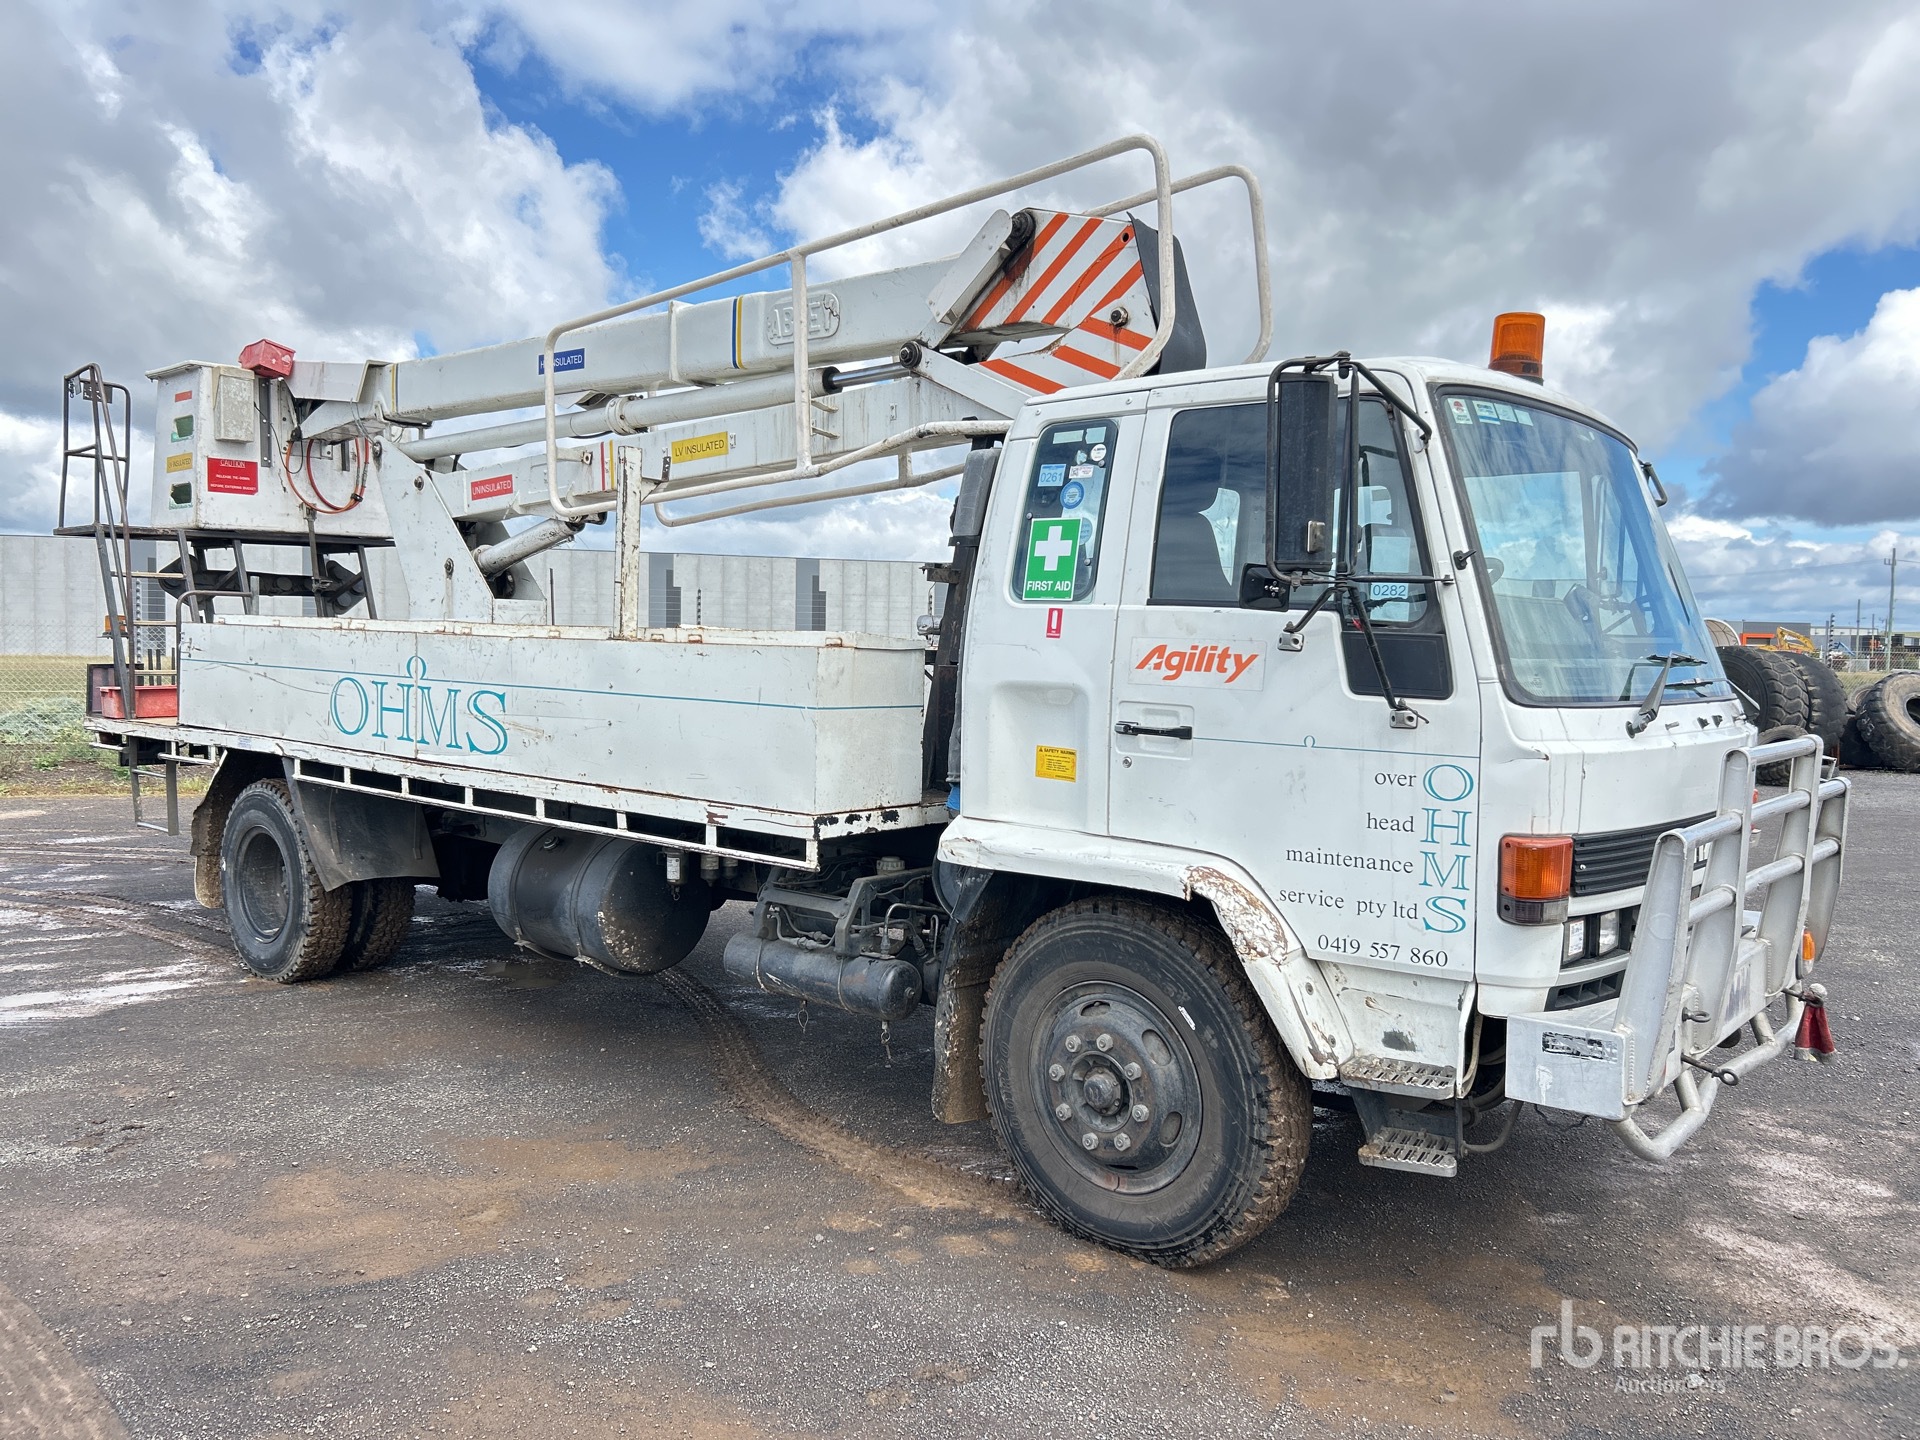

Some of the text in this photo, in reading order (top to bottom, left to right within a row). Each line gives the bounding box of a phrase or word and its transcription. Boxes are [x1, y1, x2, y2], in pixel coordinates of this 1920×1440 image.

[768, 299, 837, 339] ABEY
[675, 439, 725, 457] LV INSULATED
[473, 480, 512, 495] UNINSULATED
[1040, 472, 1063, 483] 0261
[1027, 581, 1071, 591] FIRST AID
[1372, 584, 1407, 597] 0282
[1135, 644, 1259, 684] Agility
[330, 677, 508, 755] OHMS
[1374, 772, 1417, 787] over
[1366, 813, 1415, 833] head
[1286, 848, 1414, 874] maintenance
[1279, 889, 1418, 920] service pty ltd
[1317, 934, 1449, 967] 0419 557 860
